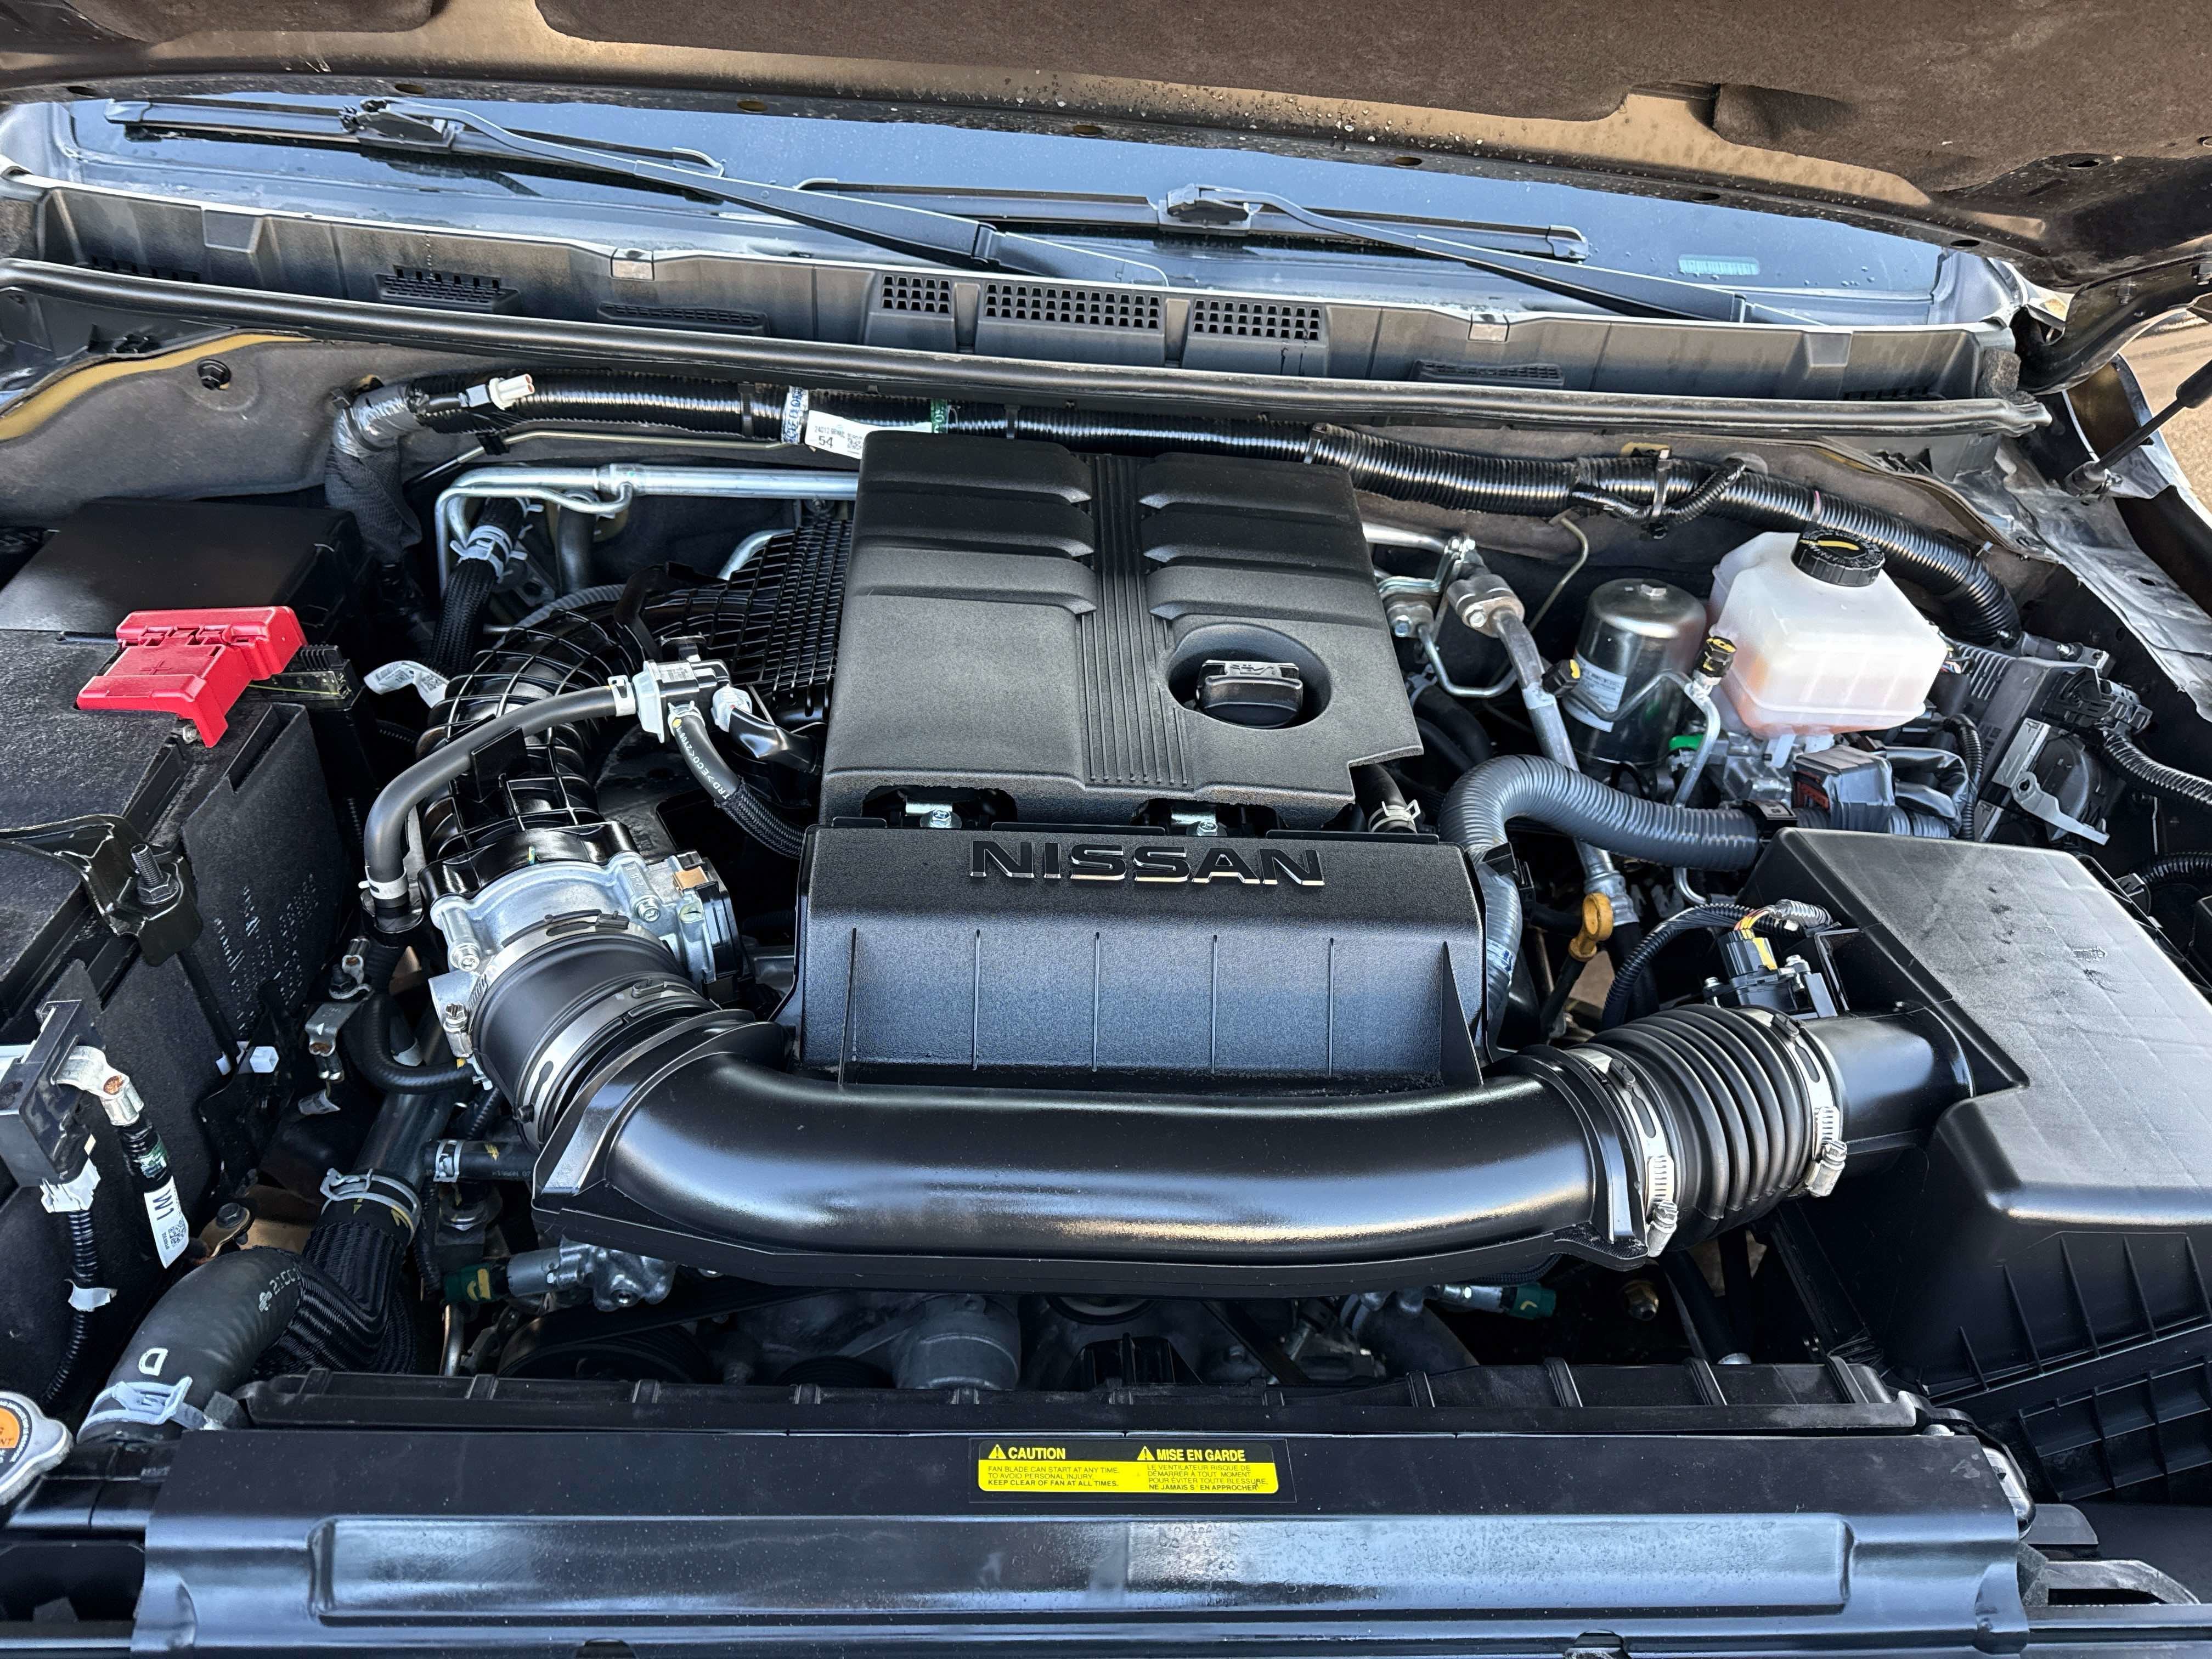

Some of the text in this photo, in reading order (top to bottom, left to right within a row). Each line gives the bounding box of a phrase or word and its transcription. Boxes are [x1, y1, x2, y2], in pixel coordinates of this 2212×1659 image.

[819, 436, 834, 448] 54
[970, 840, 1325, 886] NISSAN
[1008, 1447, 1066, 1460] CAUTION
[1156, 1449, 1246, 1462] MISE EN GARDE
